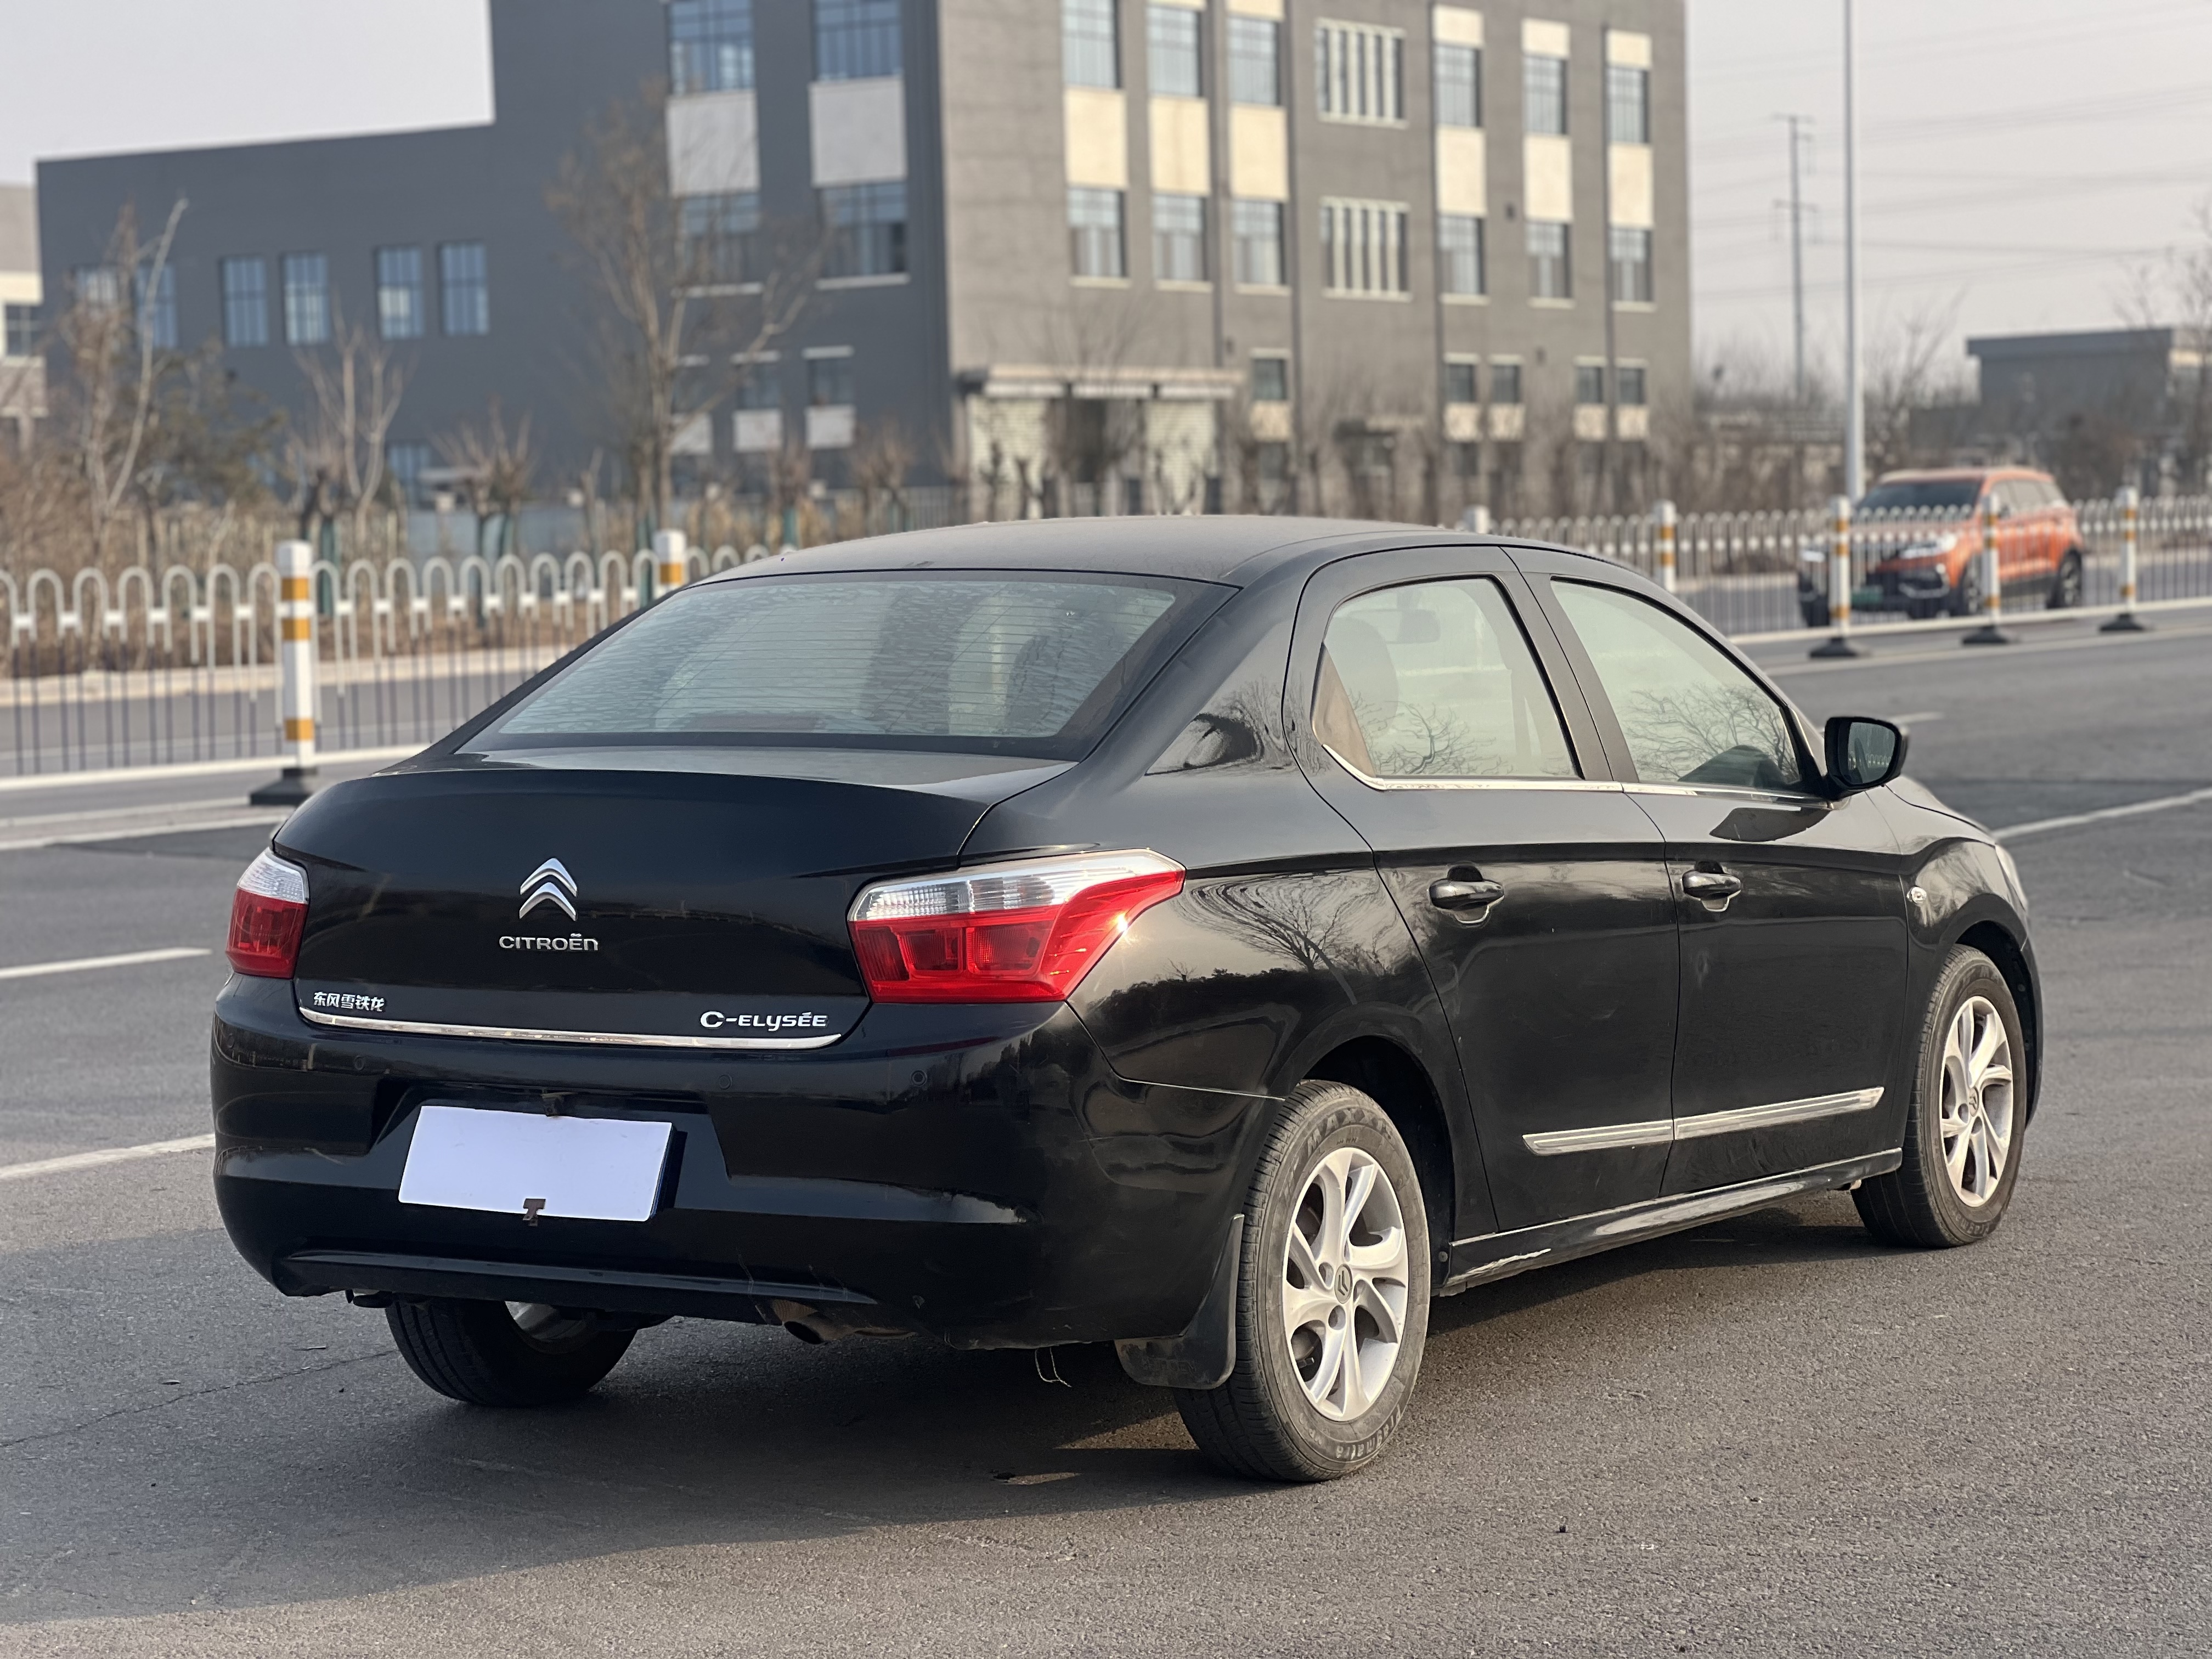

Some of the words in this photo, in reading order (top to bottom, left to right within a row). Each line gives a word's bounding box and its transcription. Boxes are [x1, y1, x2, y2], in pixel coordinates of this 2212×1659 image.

[313, 991, 385, 1012] 东风雪铁龙
[700, 1011, 828, 1032] C-ELYSÉE
[1307, 1108, 1393, 1158] MAXXIS
[1335, 1404, 1402, 1460] Pragmatra
